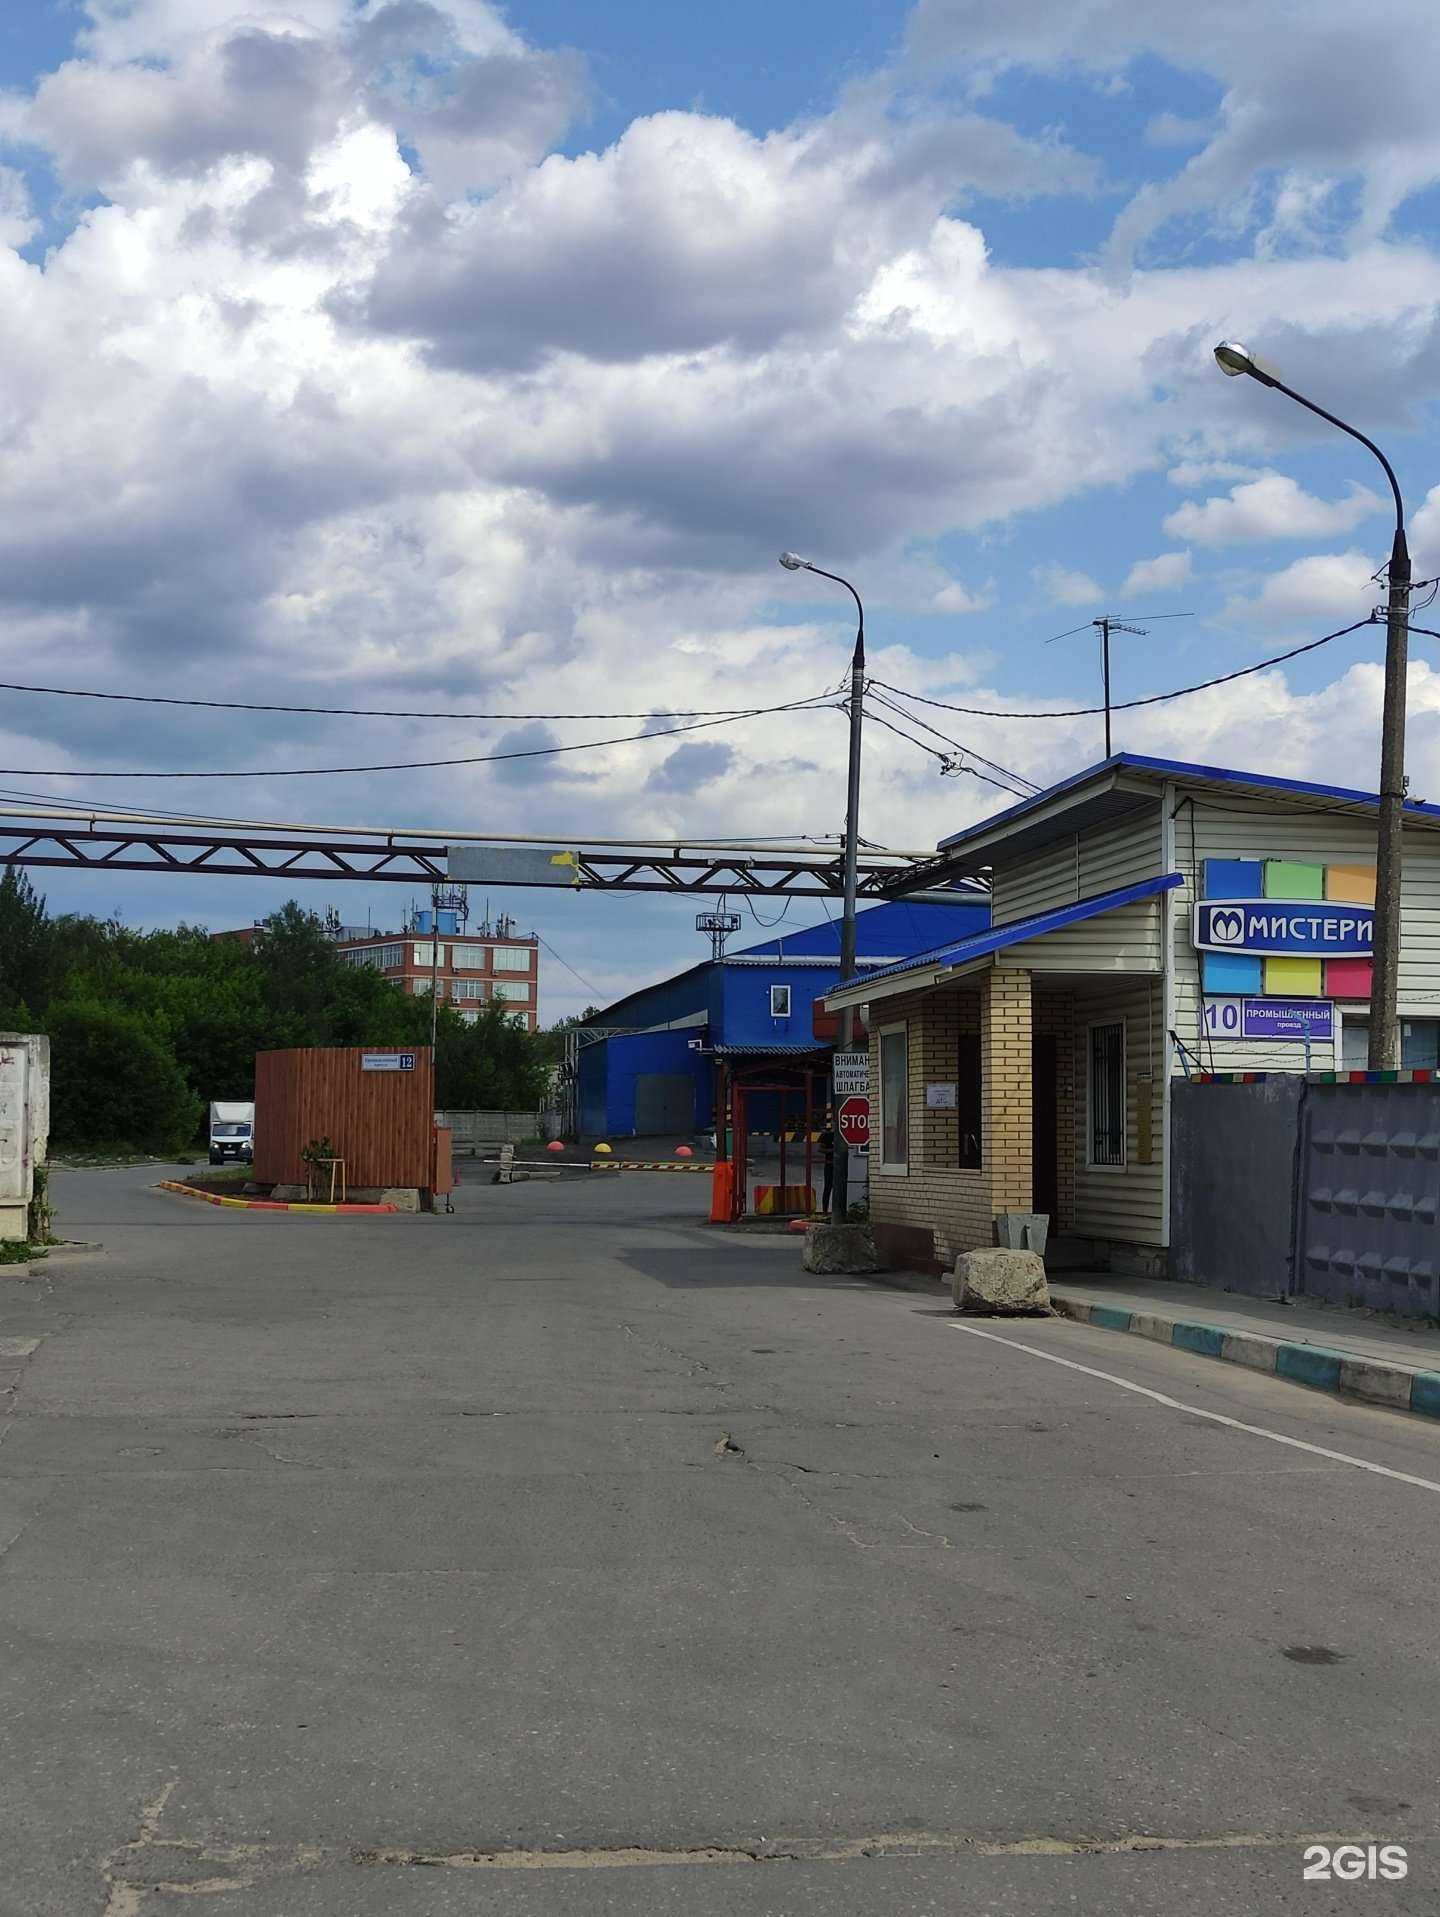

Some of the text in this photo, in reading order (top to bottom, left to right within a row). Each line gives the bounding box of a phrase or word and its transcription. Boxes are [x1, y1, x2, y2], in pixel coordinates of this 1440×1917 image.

[1206, 1004, 1238, 1029] 10
[402, 1056, 412, 1068] 12
[841, 1115, 869, 1128] STO
